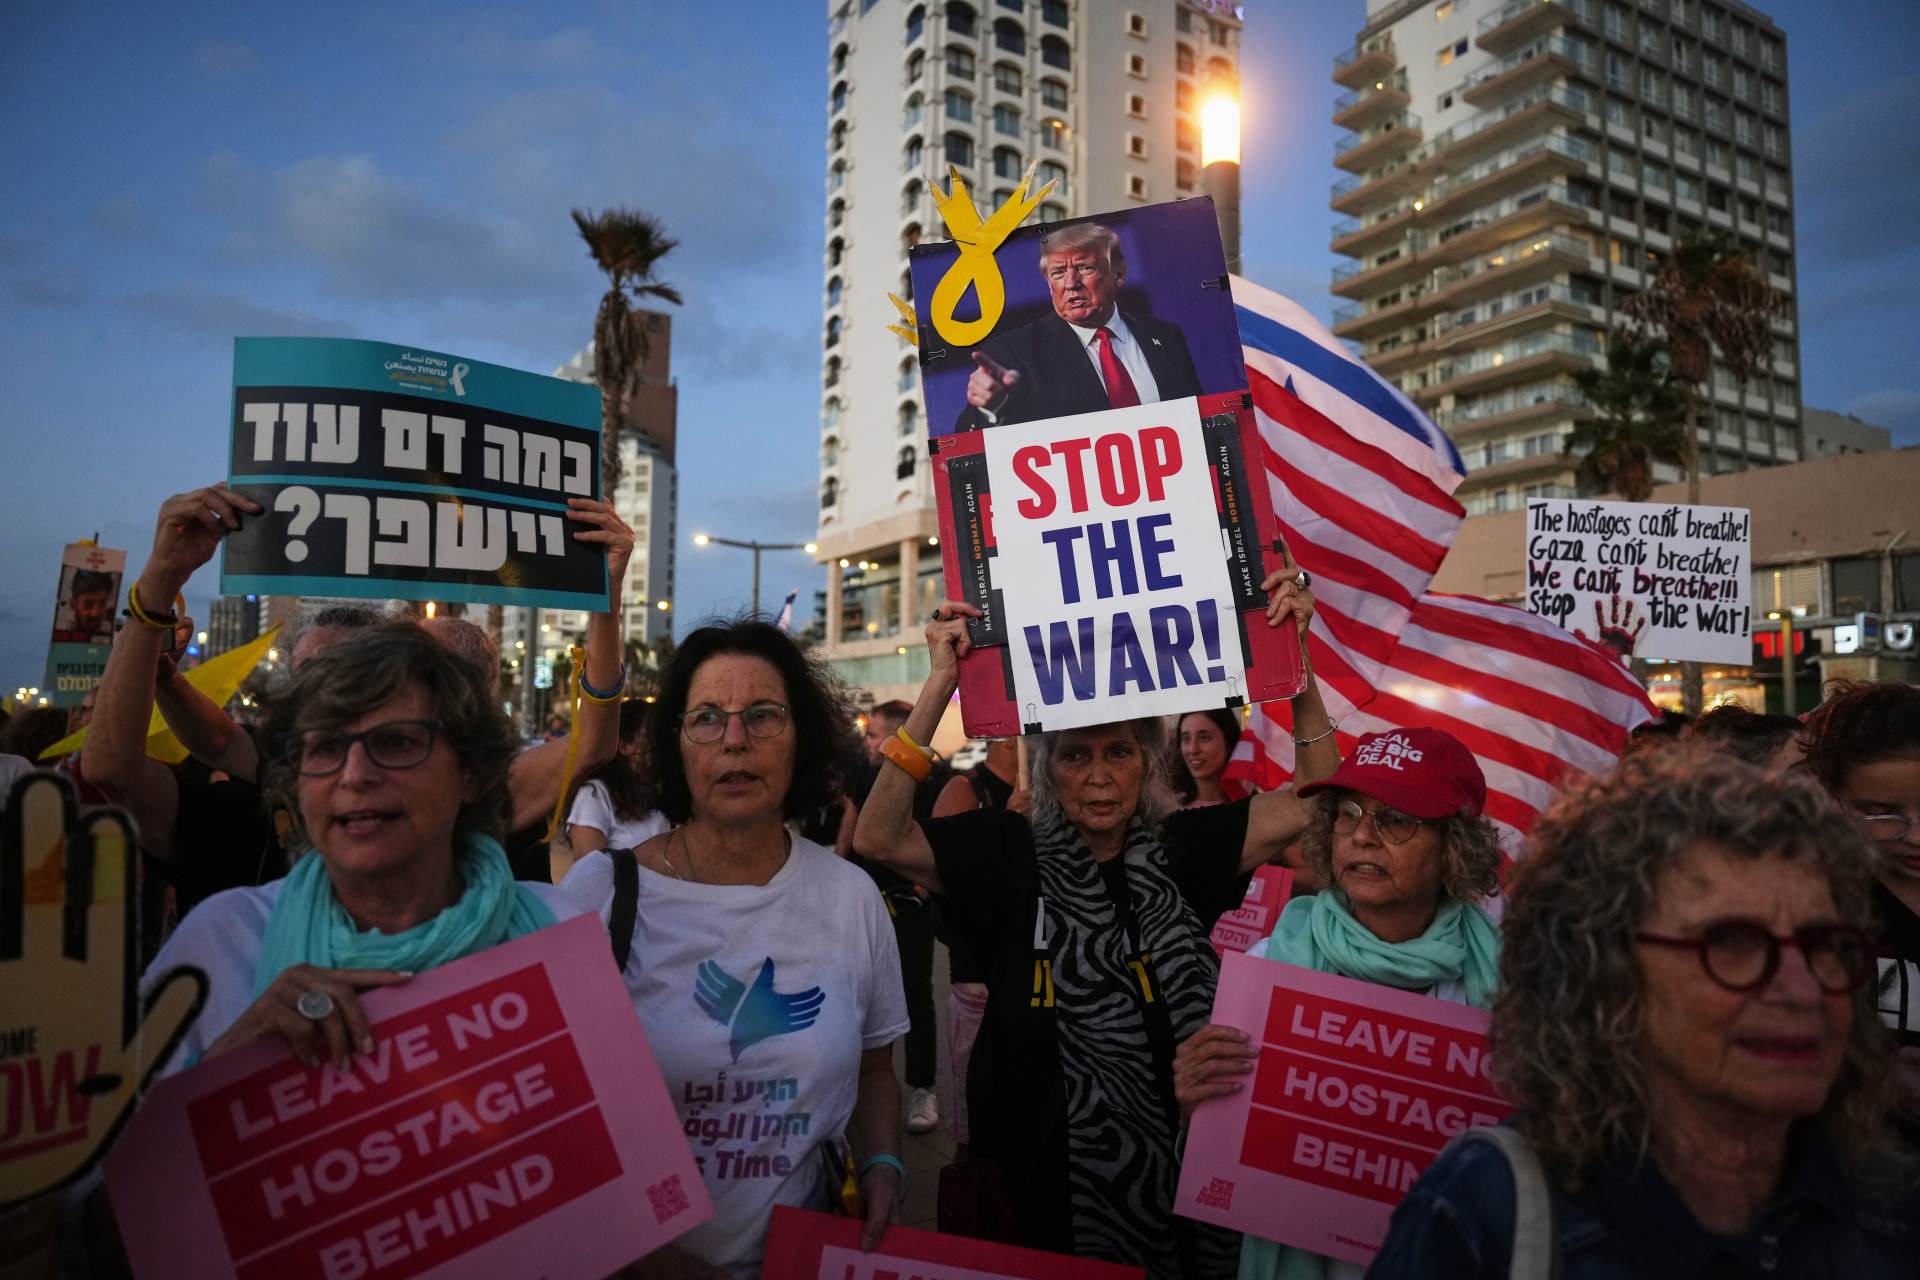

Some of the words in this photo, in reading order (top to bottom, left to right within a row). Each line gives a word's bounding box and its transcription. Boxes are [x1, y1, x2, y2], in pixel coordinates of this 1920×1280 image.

[243, 402, 361, 464] עוד
[381, 408, 467, 475] דם
[484, 424, 592, 497] כמה
[1012, 426, 1184, 520] STOP
[1221, 445, 1231, 476] AGAIN
[965, 483, 976, 514] AGAIN
[1225, 480, 1239, 524] NORMAL
[274, 485, 565, 575] יישפך?
[970, 516, 982, 560] NORMAL
[1529, 502, 1563, 533] The
[1567, 503, 1631, 541] hostages
[1686, 509, 1749, 543] breathe!
[1041, 513, 1184, 605] THE
[1234, 527, 1247, 565] ISRAEL
[1529, 535, 1587, 563] Gaza
[1657, 543, 1739, 578] breathe!
[976, 563, 988, 600] ISRAEL
[1241, 568, 1254, 596] MAKE
[1529, 560, 1561, 590] We
[1633, 567, 1738, 603] breathe!!!
[983, 602, 993, 632] MAKE
[1646, 597, 1688, 628] the
[1023, 598, 1226, 706] WAR!
[1355, 744, 1384, 756] THE
[1385, 743, 1424, 763] BIG
[1356, 753, 1404, 771] DEAL
[1291, 1004, 1434, 1066] LEAVE
[228, 1023, 440, 1142] LEAVE
[446, 990, 530, 1051] NO
[260, 1062, 555, 1220] HOSTAGE
[1293, 1132, 1421, 1193] BEHIN
[716, 1149, 792, 1179] Time
[317, 1153, 555, 1280] BEHIND
